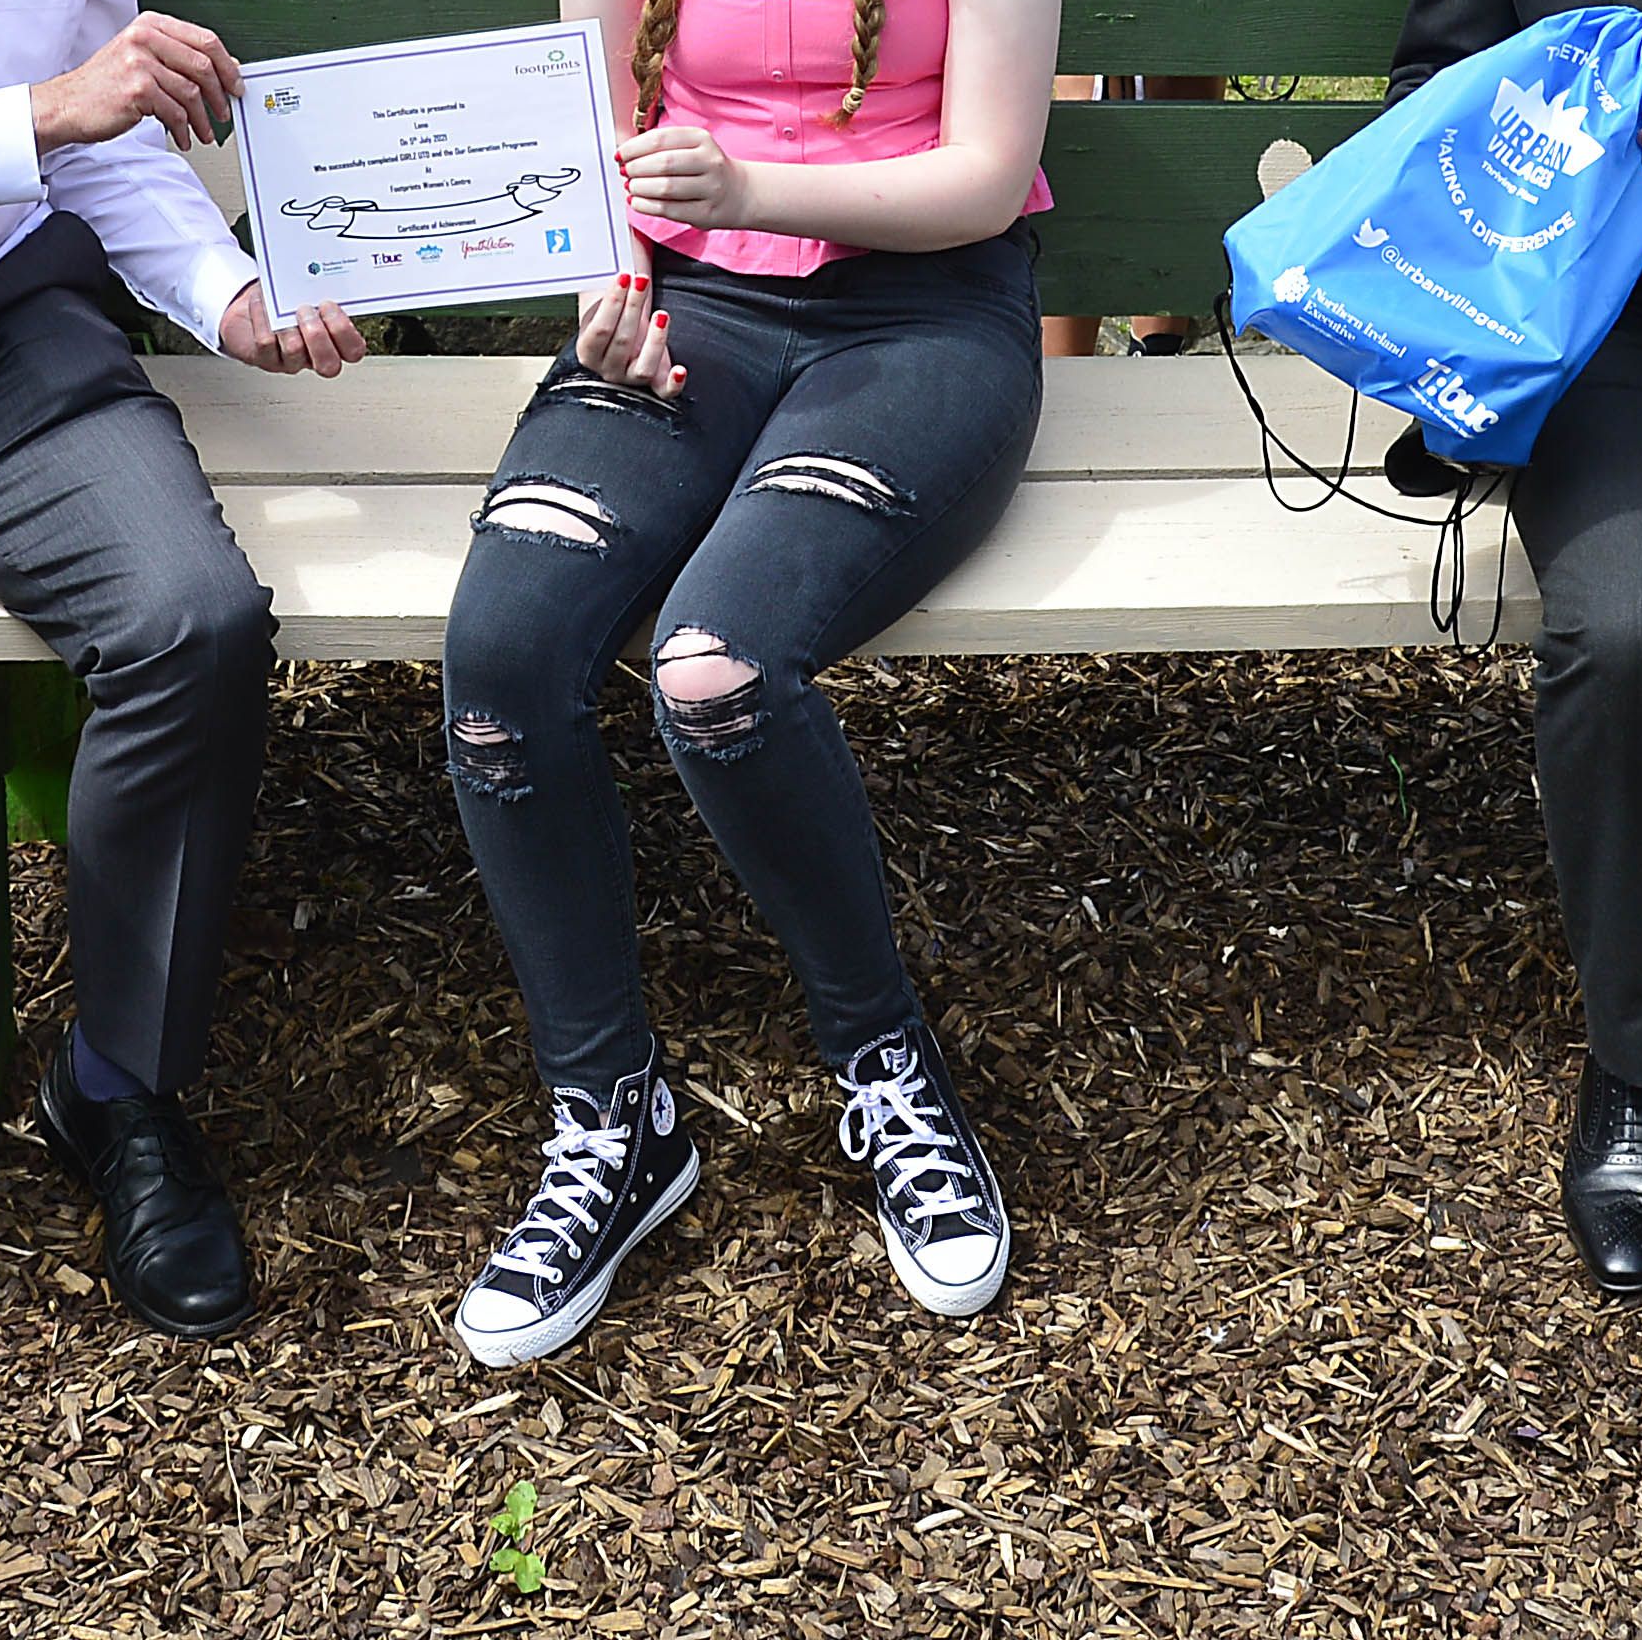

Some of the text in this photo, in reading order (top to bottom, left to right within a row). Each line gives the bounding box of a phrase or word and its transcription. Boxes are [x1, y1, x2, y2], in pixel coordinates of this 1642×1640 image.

[515, 60, 580, 75] footprints
[387, 108, 419, 117] Certificate
[427, 102, 457, 114] presented
[329, 160, 365, 170] successfully
[367, 154, 398, 165] completed
[468, 144, 500, 154] Generation
[502, 141, 537, 150] Programme
[1497, 104, 1572, 176] URBAN
[390, 184, 421, 192] Footprints
[1438, 128, 1576, 253] MAKING A DIFFERENCE
[398, 224, 429, 233] Certificate
[439, 219, 476, 228] Achievement
[371, 253, 402, 265] T:buc
[1380, 245, 1525, 346] @urbanvillagesni
[1302, 300, 1356, 342] Executive
[1310, 287, 1363, 330] Northern
[1363, 322, 1407, 358] Ireland
[1417, 358, 1499, 433] T:buc
